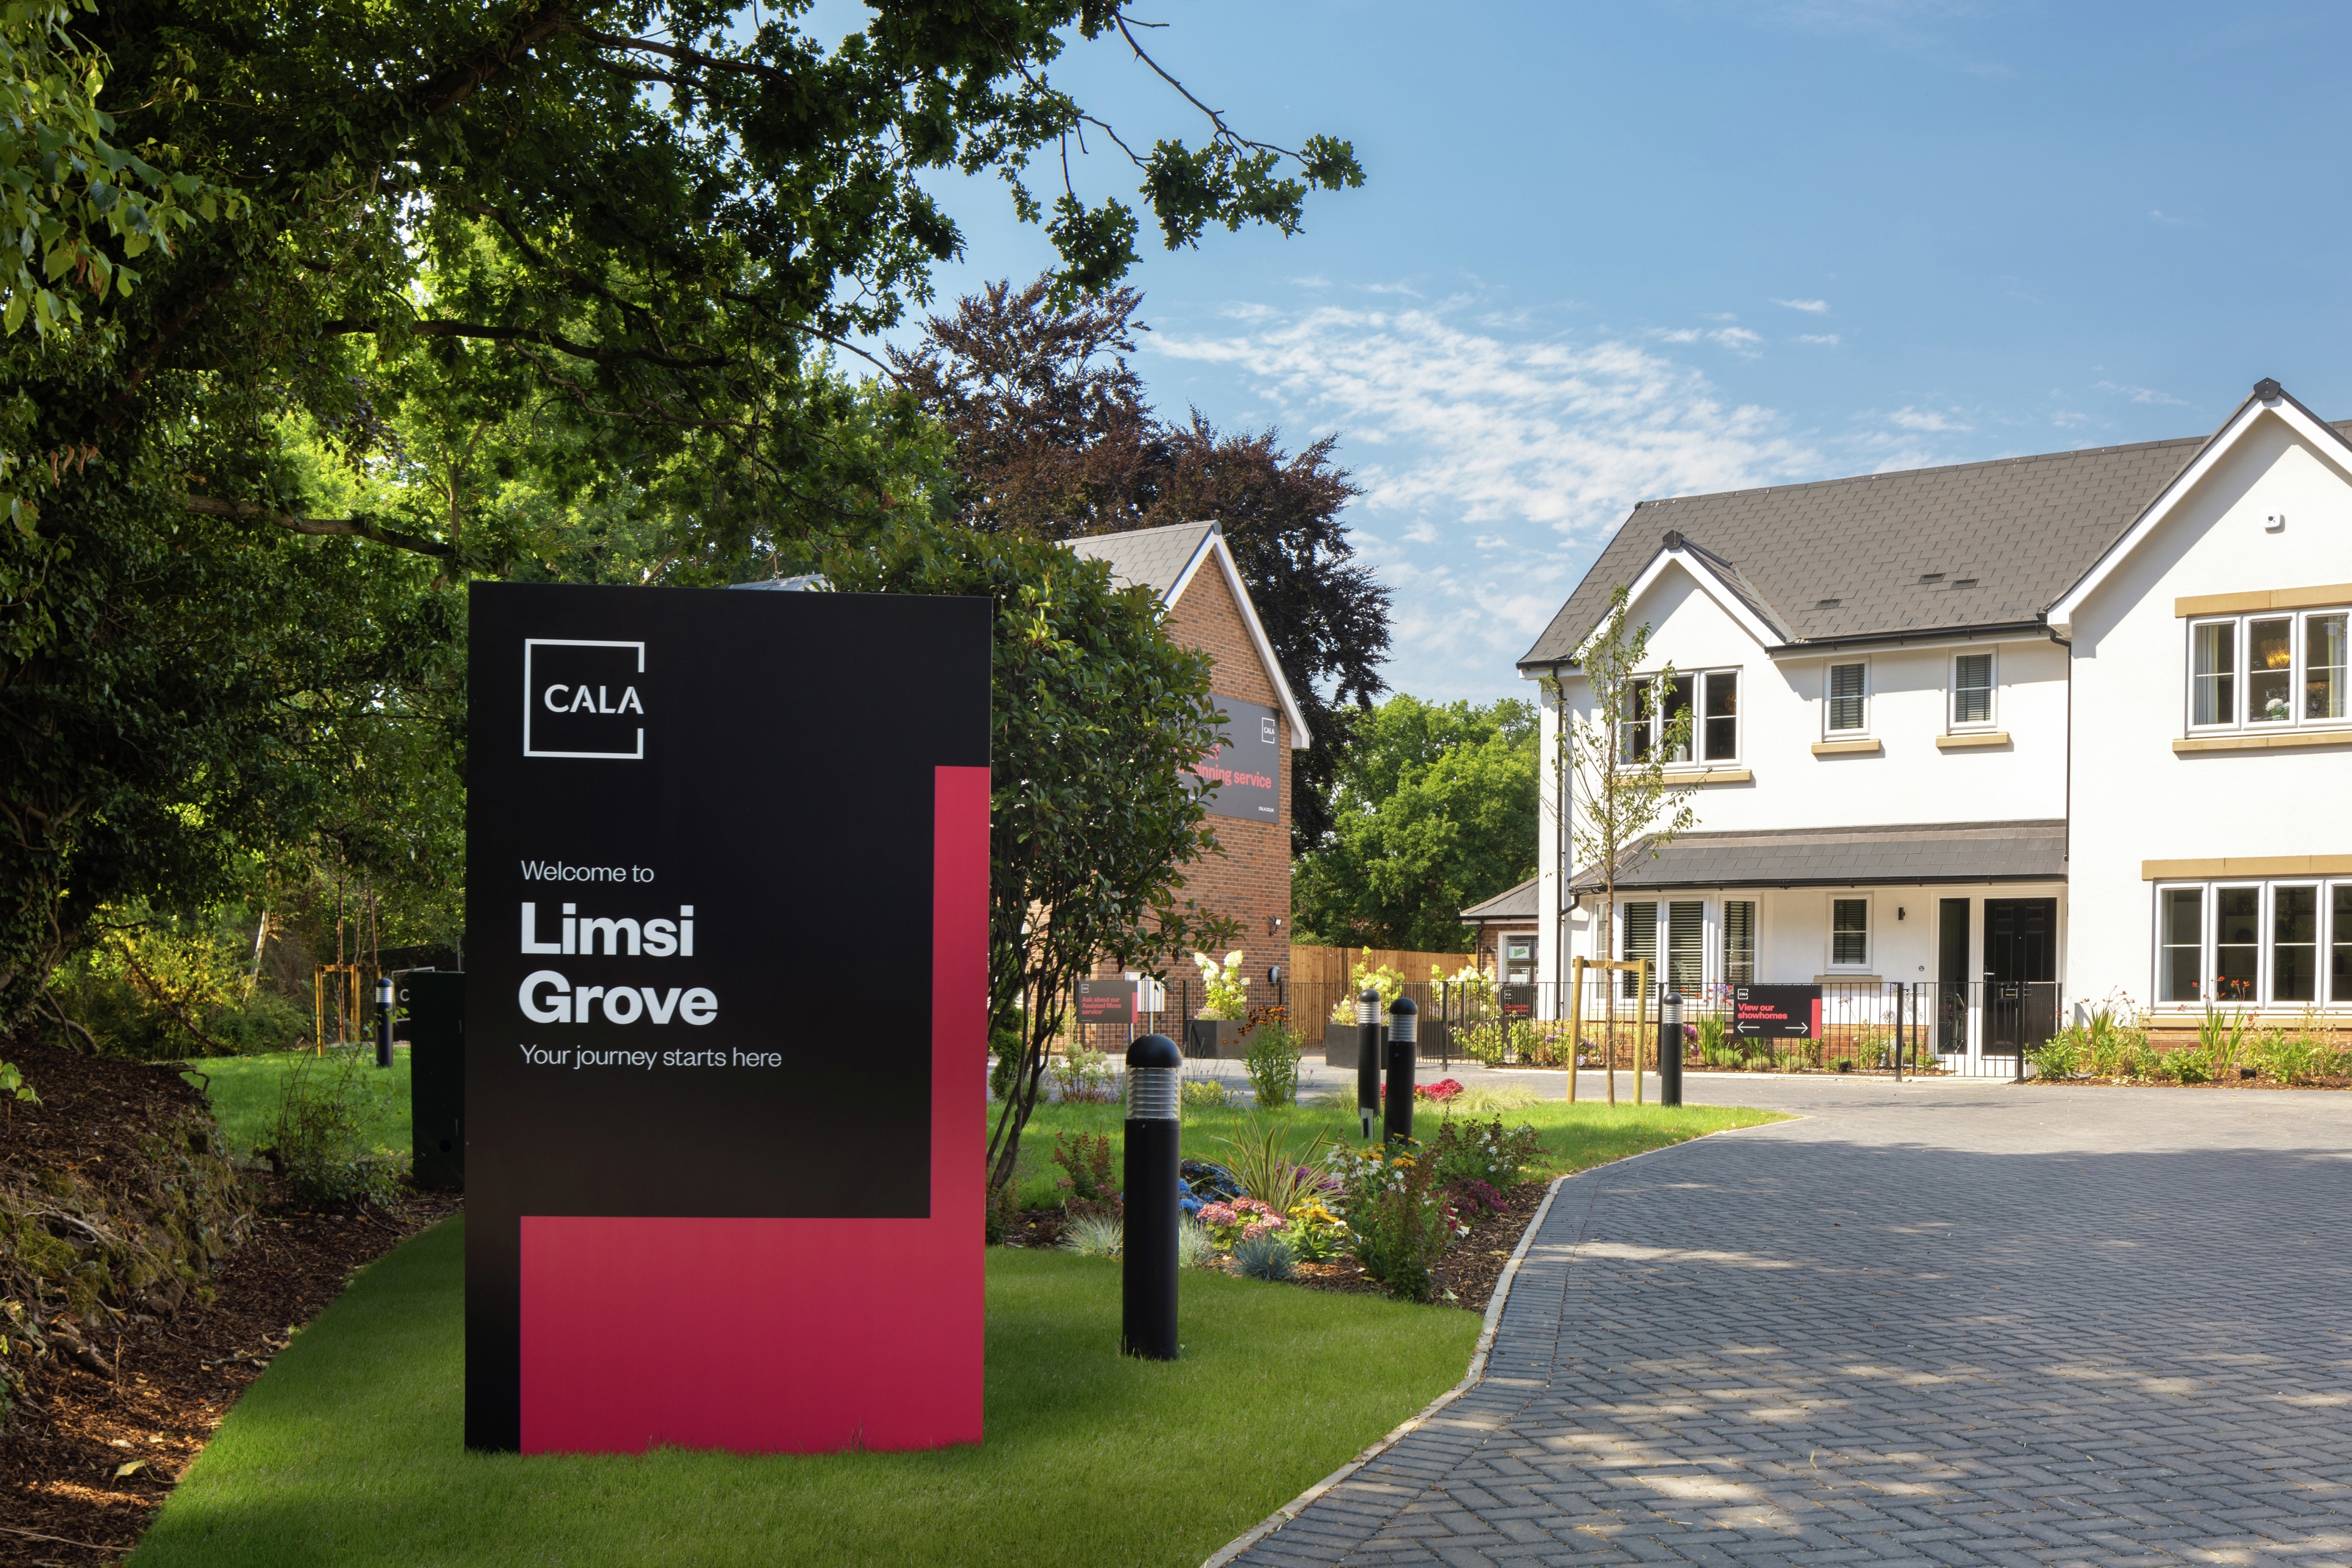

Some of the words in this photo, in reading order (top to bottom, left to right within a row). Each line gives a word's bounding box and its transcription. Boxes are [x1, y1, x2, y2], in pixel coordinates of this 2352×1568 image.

[544, 684, 645, 715] CALA
[1263, 727, 1274, 735] CALA
[1233, 771, 1272, 788] service
[520, 860, 627, 882] Welcome
[631, 864, 655, 883] to
[521, 902, 694, 957] Limsi
[518, 970, 718, 1026] Grove
[1738, 1003, 1759, 1011] View
[1738, 1011, 1788, 1019] showhomes
[519, 1043, 571, 1065] Your
[573, 1045, 658, 1071] journey
[662, 1049, 727, 1067] starts
[733, 1046, 782, 1068] here
